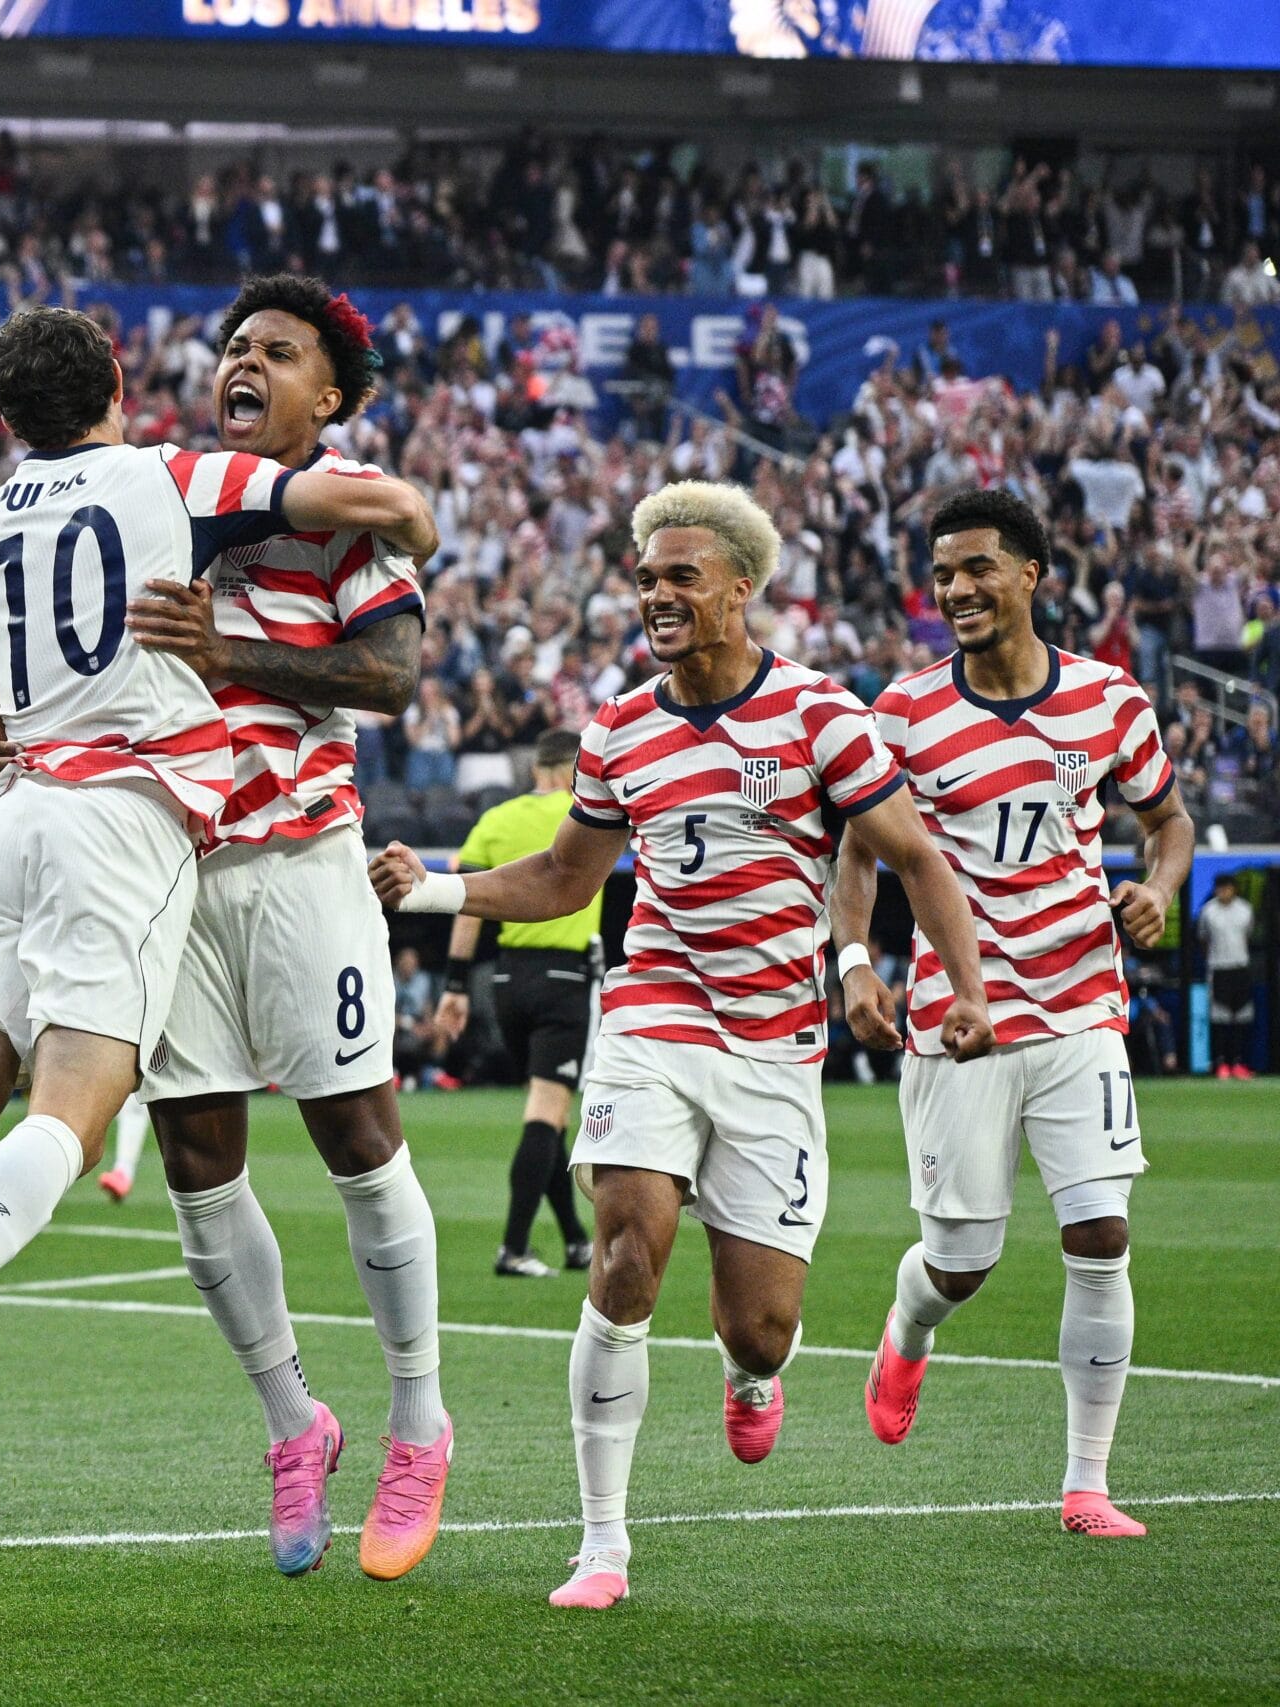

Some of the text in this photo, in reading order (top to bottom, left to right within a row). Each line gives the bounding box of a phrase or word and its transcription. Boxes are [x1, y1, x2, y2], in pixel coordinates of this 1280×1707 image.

[745, 760, 778, 780] USA
[1057, 753, 1087, 770] USA
[680, 814, 707, 875] 5
[994, 802, 1049, 863] 17
[337, 966, 365, 1040] 8
[588, 1104, 613, 1120] USA
[1098, 1070, 1132, 1132] 17
[790, 1148, 808, 1210] 5
[921, 1153, 936, 1169] USA
